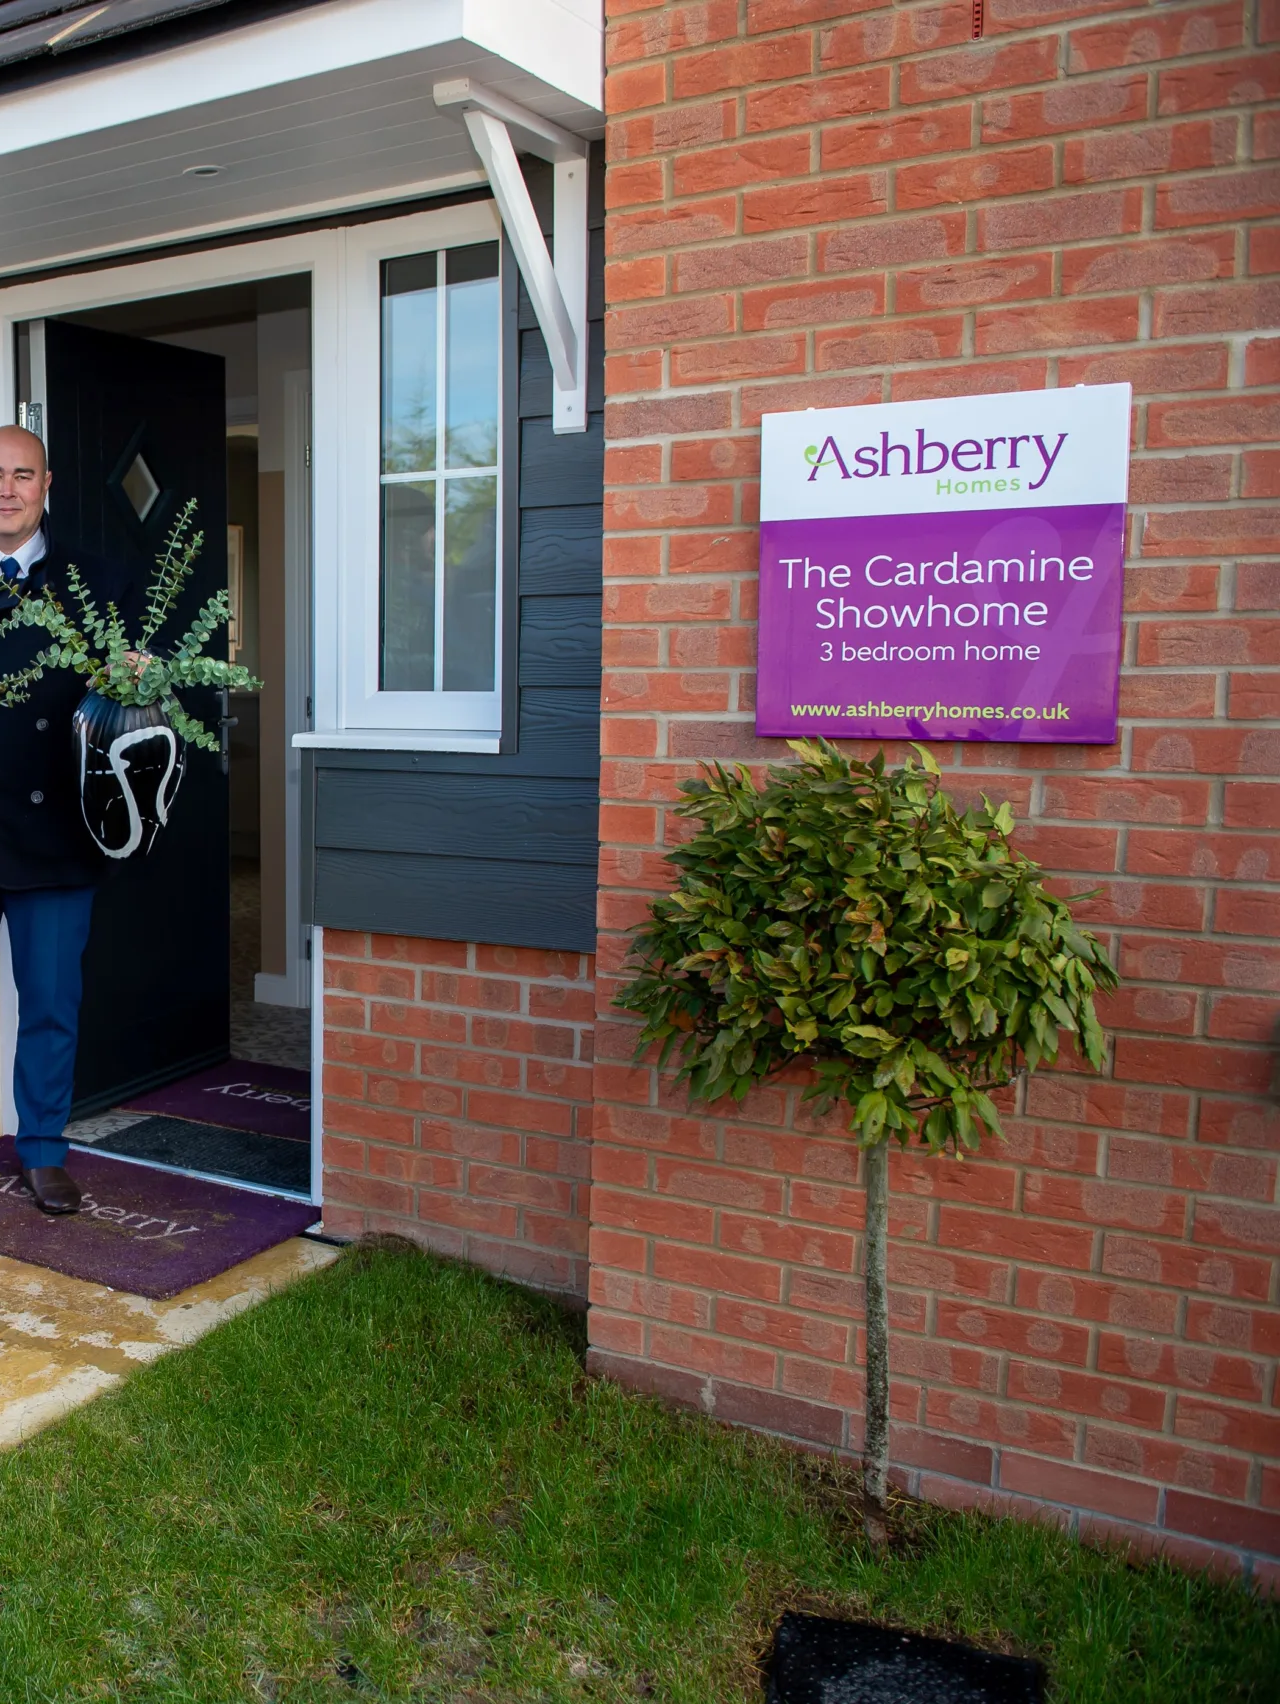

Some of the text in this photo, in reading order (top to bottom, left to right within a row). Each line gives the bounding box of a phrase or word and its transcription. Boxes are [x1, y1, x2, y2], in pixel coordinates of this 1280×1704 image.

[804, 429, 1069, 490] Ashberry
[936, 477, 1021, 496] Homes
[779, 550, 1094, 589] The Cardamine
[816, 595, 1048, 630] Showhome
[820, 640, 1041, 663] 3 bedroom home
[791, 701, 1070, 722] www.ashberryhomes.co.uk
